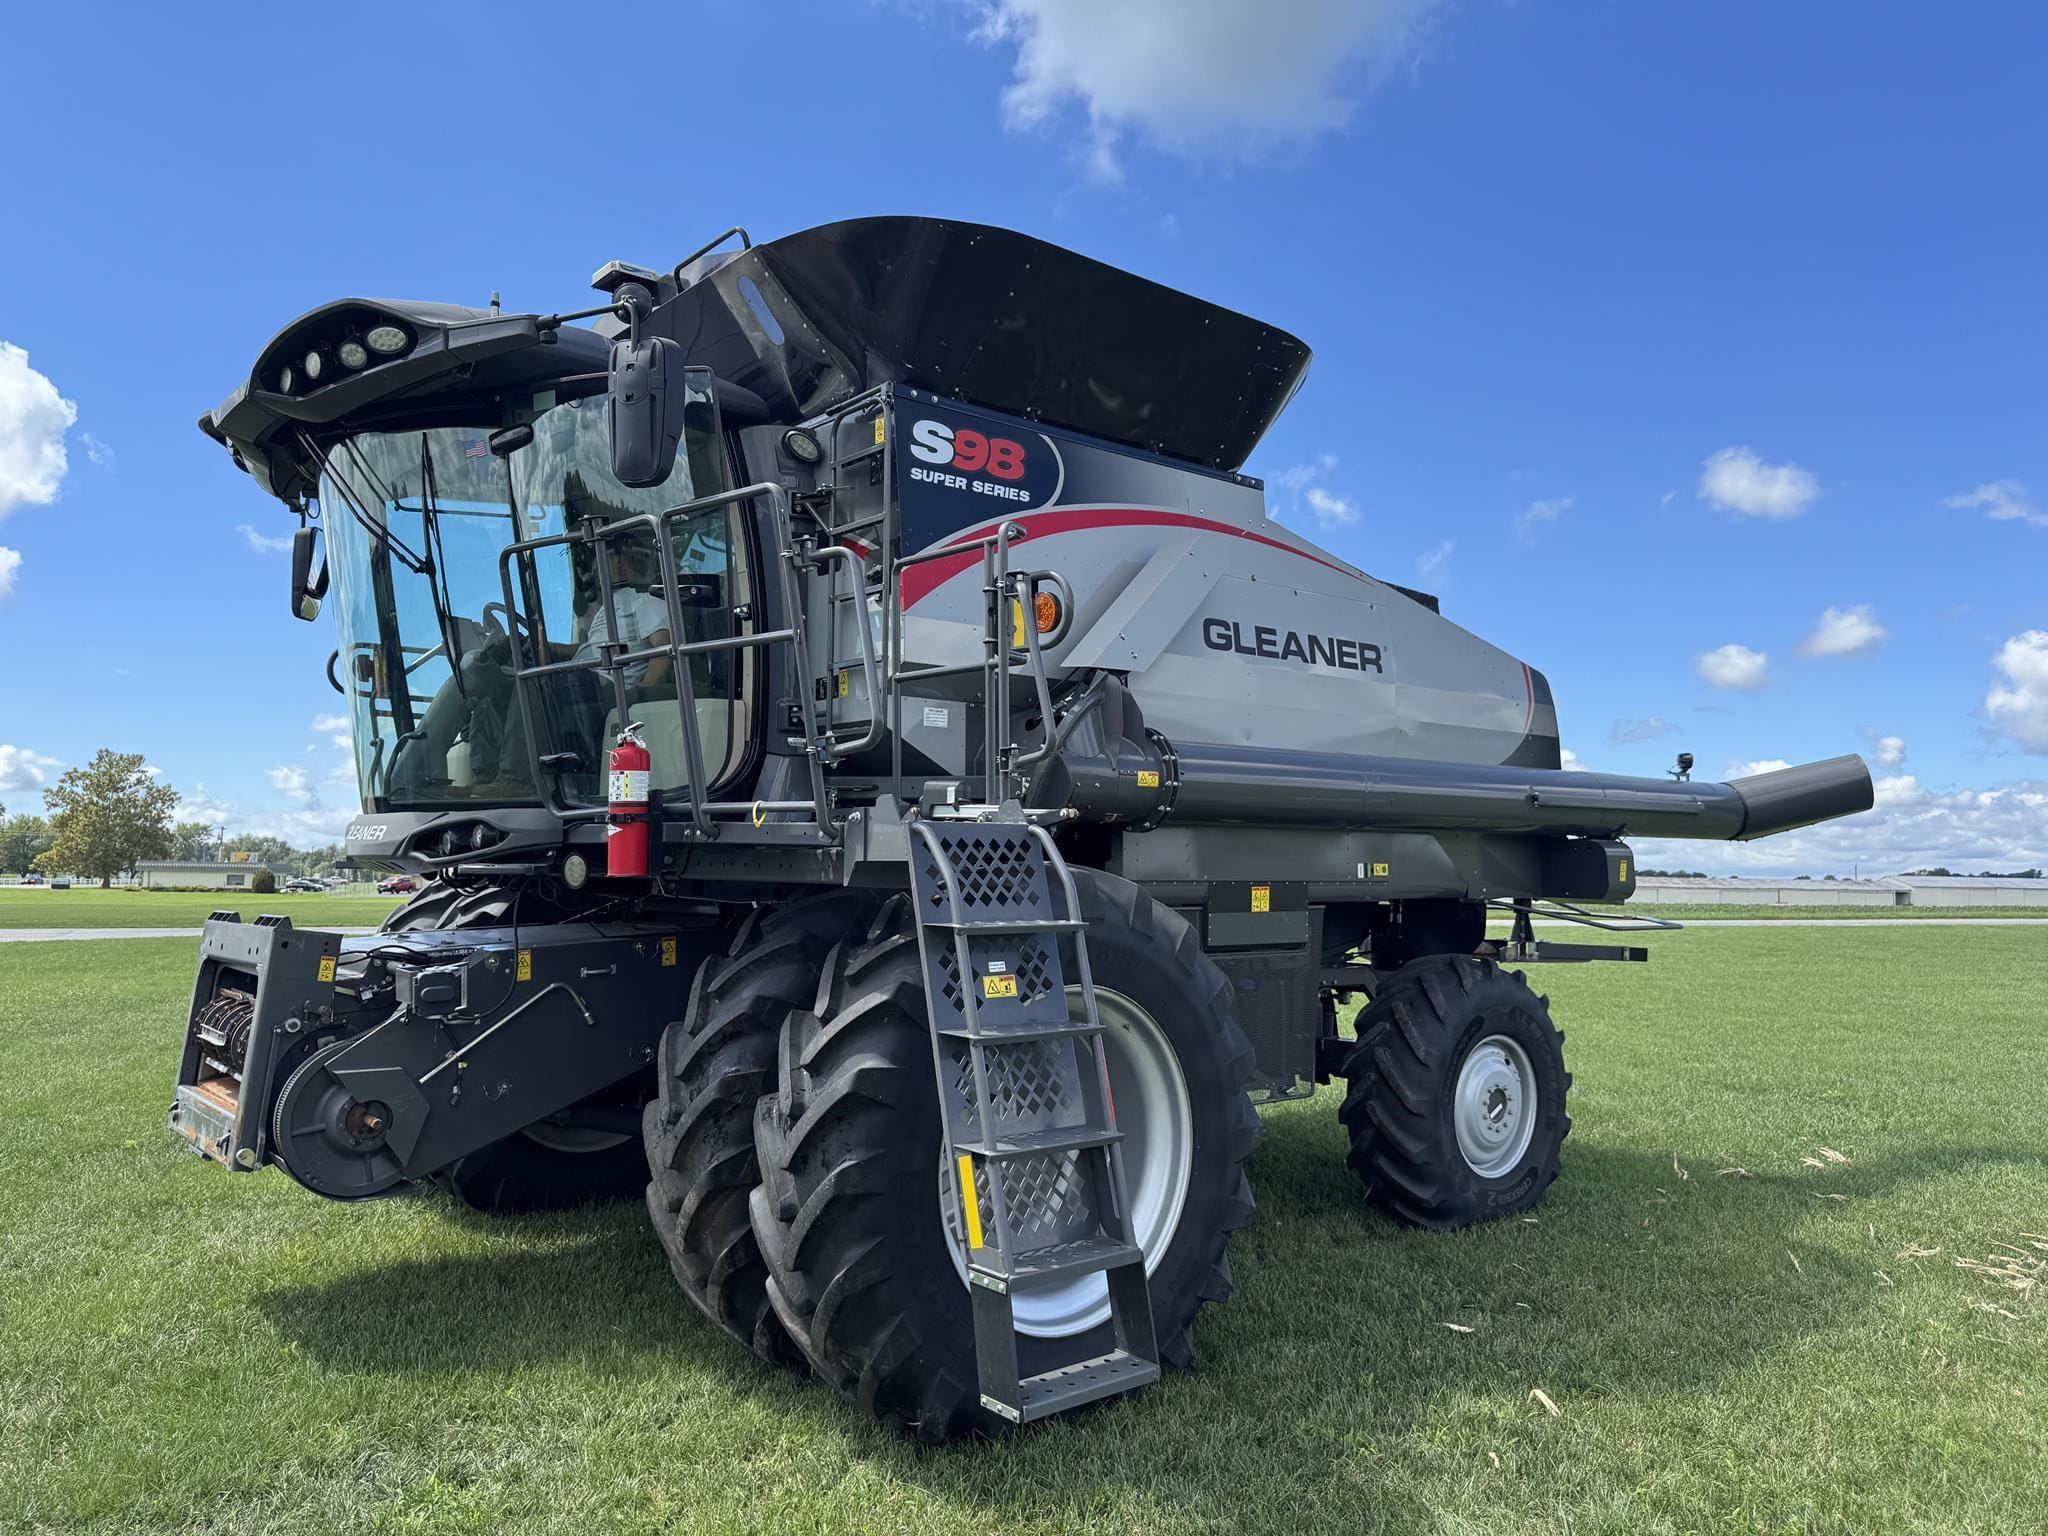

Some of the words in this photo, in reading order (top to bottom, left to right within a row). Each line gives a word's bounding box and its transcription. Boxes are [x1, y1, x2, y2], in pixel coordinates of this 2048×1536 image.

[910, 419, 1026, 481] S98
[910, 467, 967, 490] SUPER
[972, 480, 1031, 503] SERIES
[1202, 617, 1384, 674] GLEANER
[1487, 1190, 1498, 1207] 2
